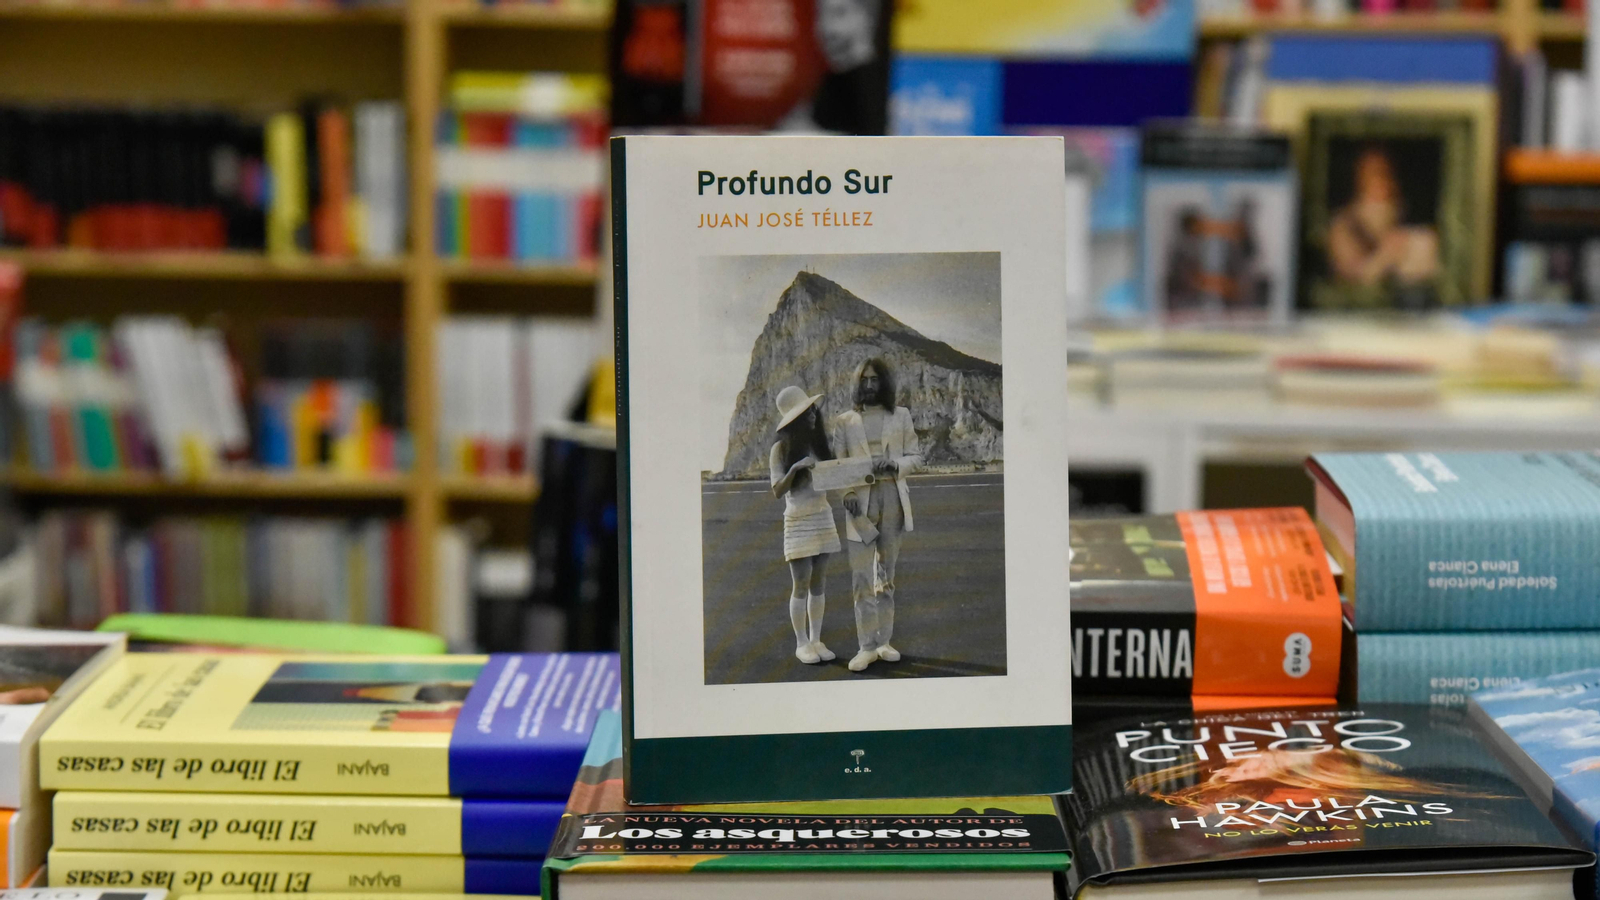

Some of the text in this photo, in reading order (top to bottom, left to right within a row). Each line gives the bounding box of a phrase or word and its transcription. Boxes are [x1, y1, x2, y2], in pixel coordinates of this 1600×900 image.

[697, 168, 893, 196] Profundo Sur
[697, 208, 873, 228] JUAN JOSÉ TÉLLEZ
[1481, 560, 1520, 574] Elena
[1499, 577, 1557, 590] Soledad
[1071, 628, 1194, 678] NTERNA
[1291, 638, 1302, 673] SUMA
[1115, 718, 1404, 748] PUNTO
[1129, 736, 1411, 763] CIEGO
[57, 757, 301, 781] El libro de las casas
[337, 762, 390, 777] BAJANI
[1214, 795, 1398, 814] PAULA
[623, 816, 711, 824] NUEVA
[720, 817, 826, 825] NOVELA
[1169, 803, 1454, 830] HAWKINS
[1366, 820, 1433, 829] VENIR
[71, 816, 317, 841] El libro de las casas
[353, 823, 406, 838] BAJANI
[579, 825, 1031, 843] Los asquerosos
[65, 870, 312, 894] El libro de las casas
[348, 872, 401, 889] BAJANI
